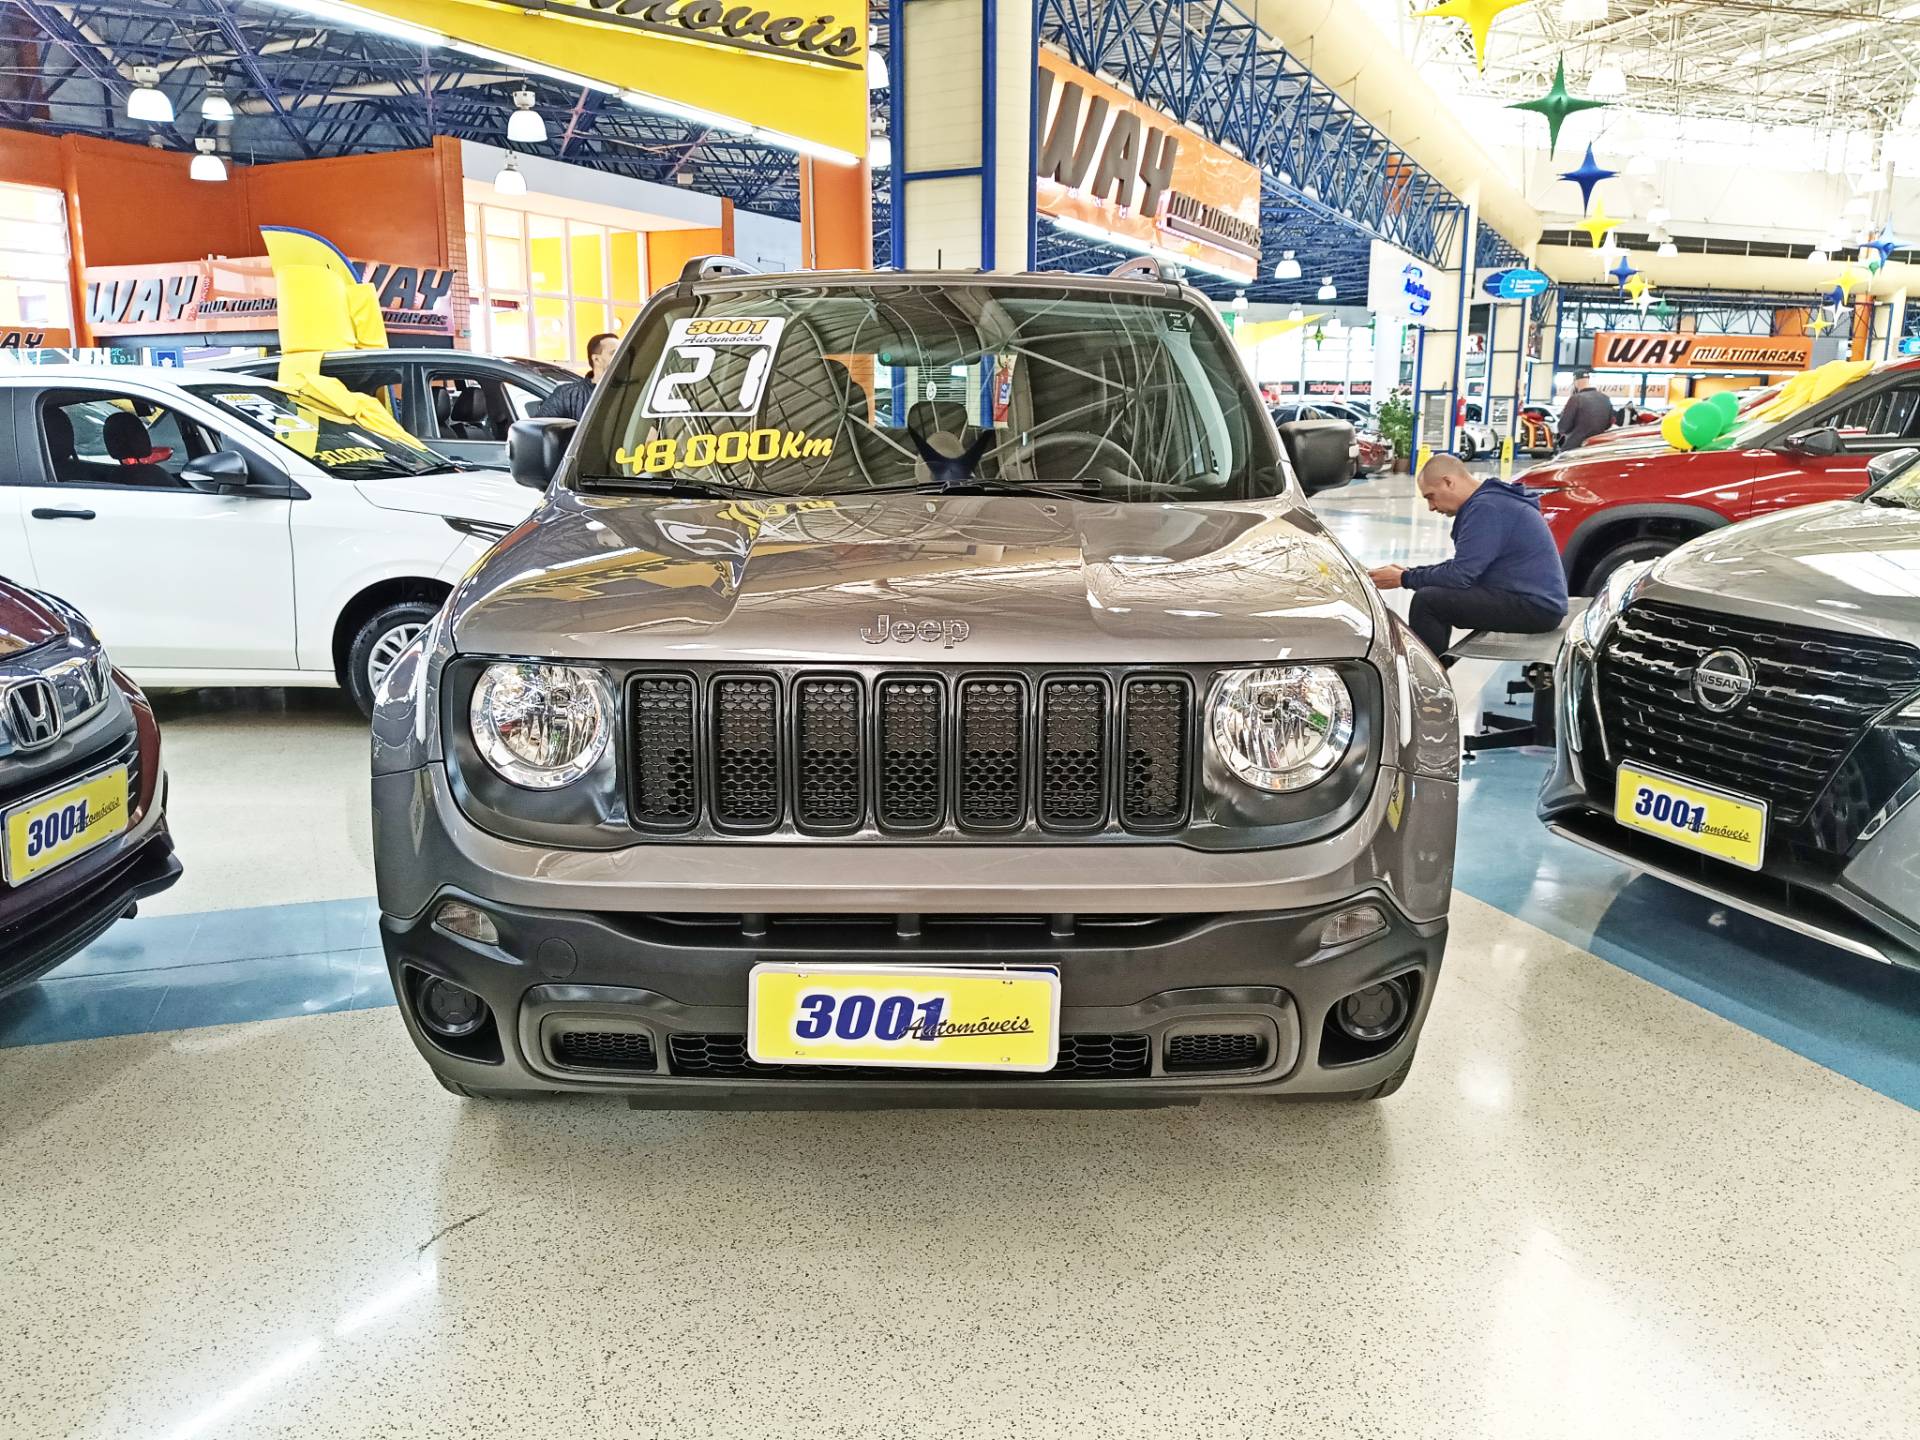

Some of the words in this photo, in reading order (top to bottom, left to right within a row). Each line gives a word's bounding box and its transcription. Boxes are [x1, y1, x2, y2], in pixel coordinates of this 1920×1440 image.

[1038, 66, 1179, 219] WAY
[1168, 191, 1262, 247] MULTIMARCAS
[87, 275, 199, 325] WAY
[0, 332, 44, 348] AY
[685, 320, 769, 335] 3001
[1606, 338, 1691, 364] WAY
[1692, 346, 1807, 363] MULTIMARCAS
[650, 346, 768, 412] 21
[615, 429, 833, 475] 48.000Km
[860, 614, 970, 649] Jeep
[1699, 672, 1742, 690] NISSAN
[28, 800, 87, 857] 3001
[1635, 788, 1705, 834] 3001
[796, 994, 945, 1041] 3001
[898, 1015, 1032, 1040] Automóveis
